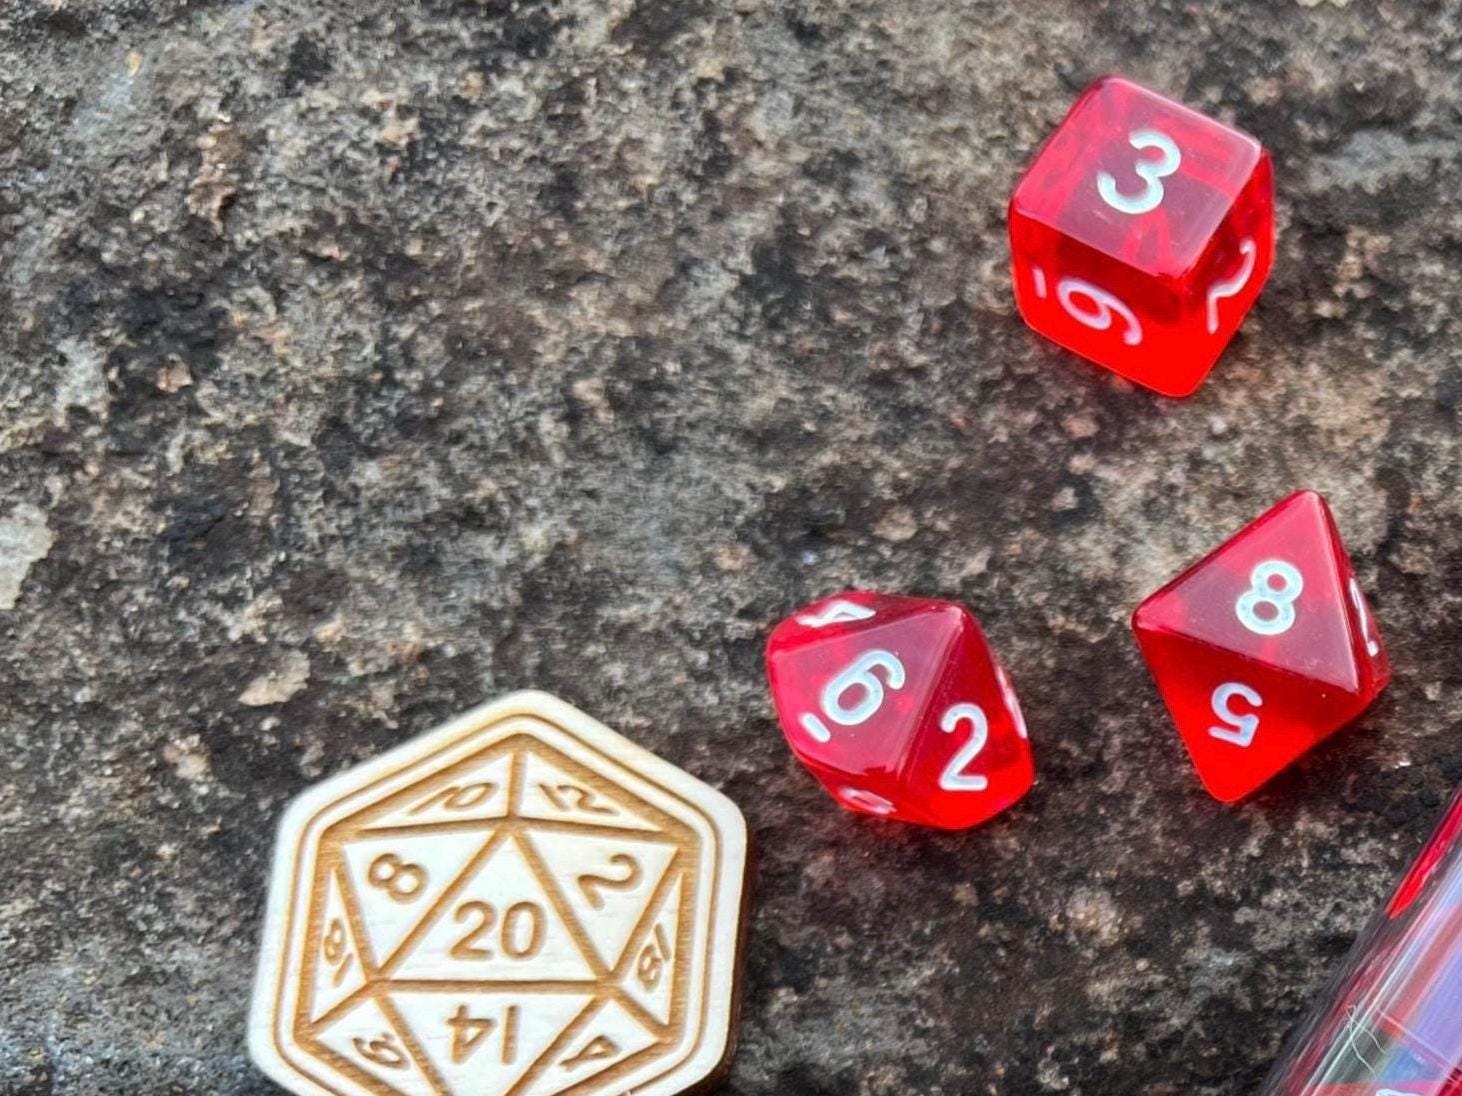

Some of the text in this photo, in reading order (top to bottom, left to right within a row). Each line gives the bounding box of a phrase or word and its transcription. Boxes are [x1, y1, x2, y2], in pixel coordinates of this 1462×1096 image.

[1096, 128, 1182, 215] 3
[1206, 236, 1257, 335] 2
[1235, 559, 1304, 636] 8
[1207, 681, 1264, 748] 5
[938, 702, 989, 792] 2
[406, 781, 495, 815] 10
[538, 783, 622, 817] 12
[367, 853, 427, 900] 8
[577, 853, 644, 910] 2
[449, 900, 549, 962] 20
[445, 1003, 523, 1067] 14
[560, 1034, 622, 1074] 4
